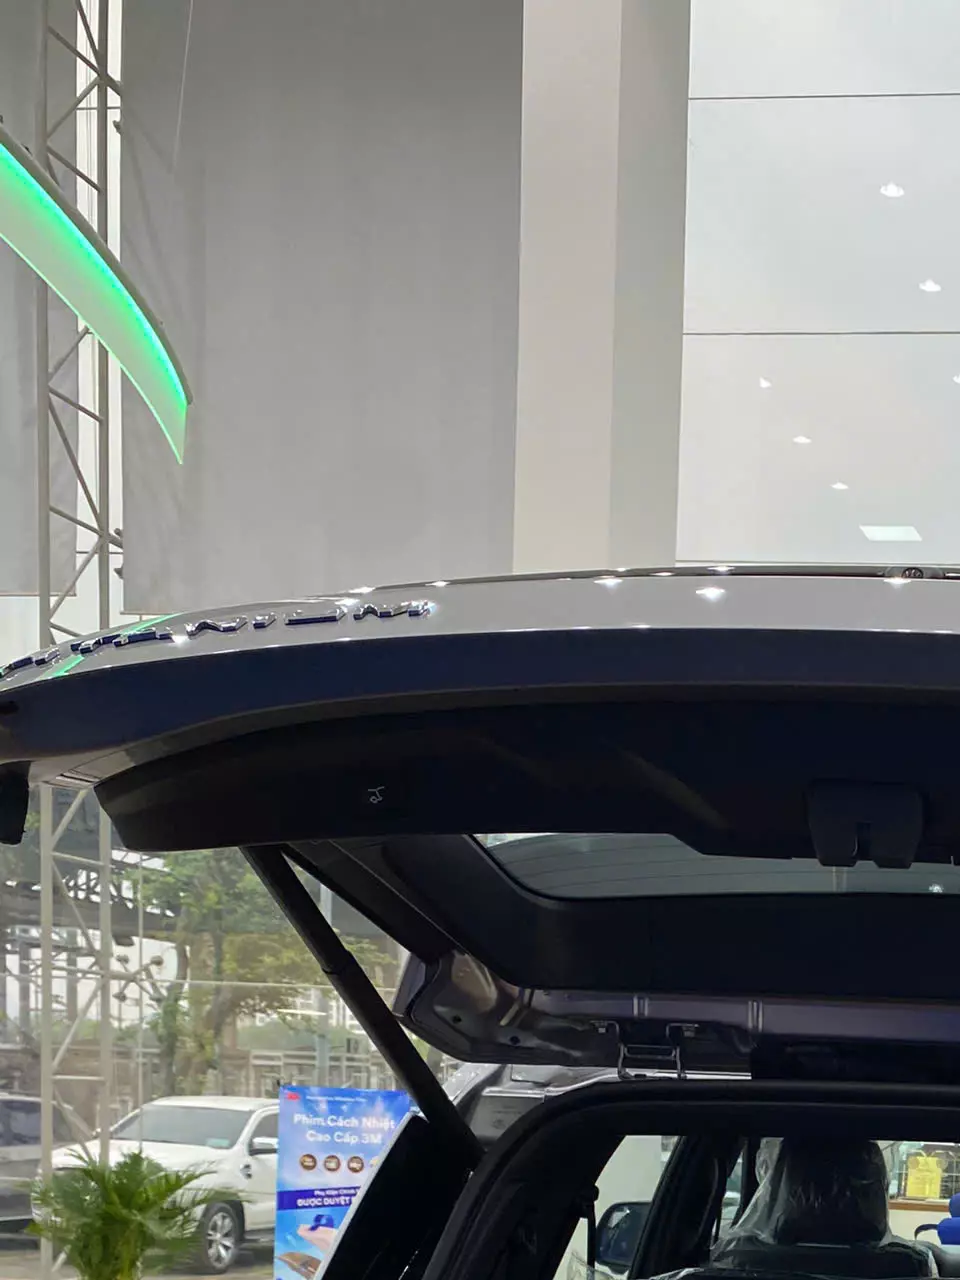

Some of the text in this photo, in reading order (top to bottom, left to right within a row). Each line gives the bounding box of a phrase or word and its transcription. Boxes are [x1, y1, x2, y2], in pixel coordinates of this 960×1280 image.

[293, 1113, 396, 1132] Phim Cách Nhiệt
[305, 1130, 332, 1142] Cao
[361, 1132, 383, 1144] 3M
